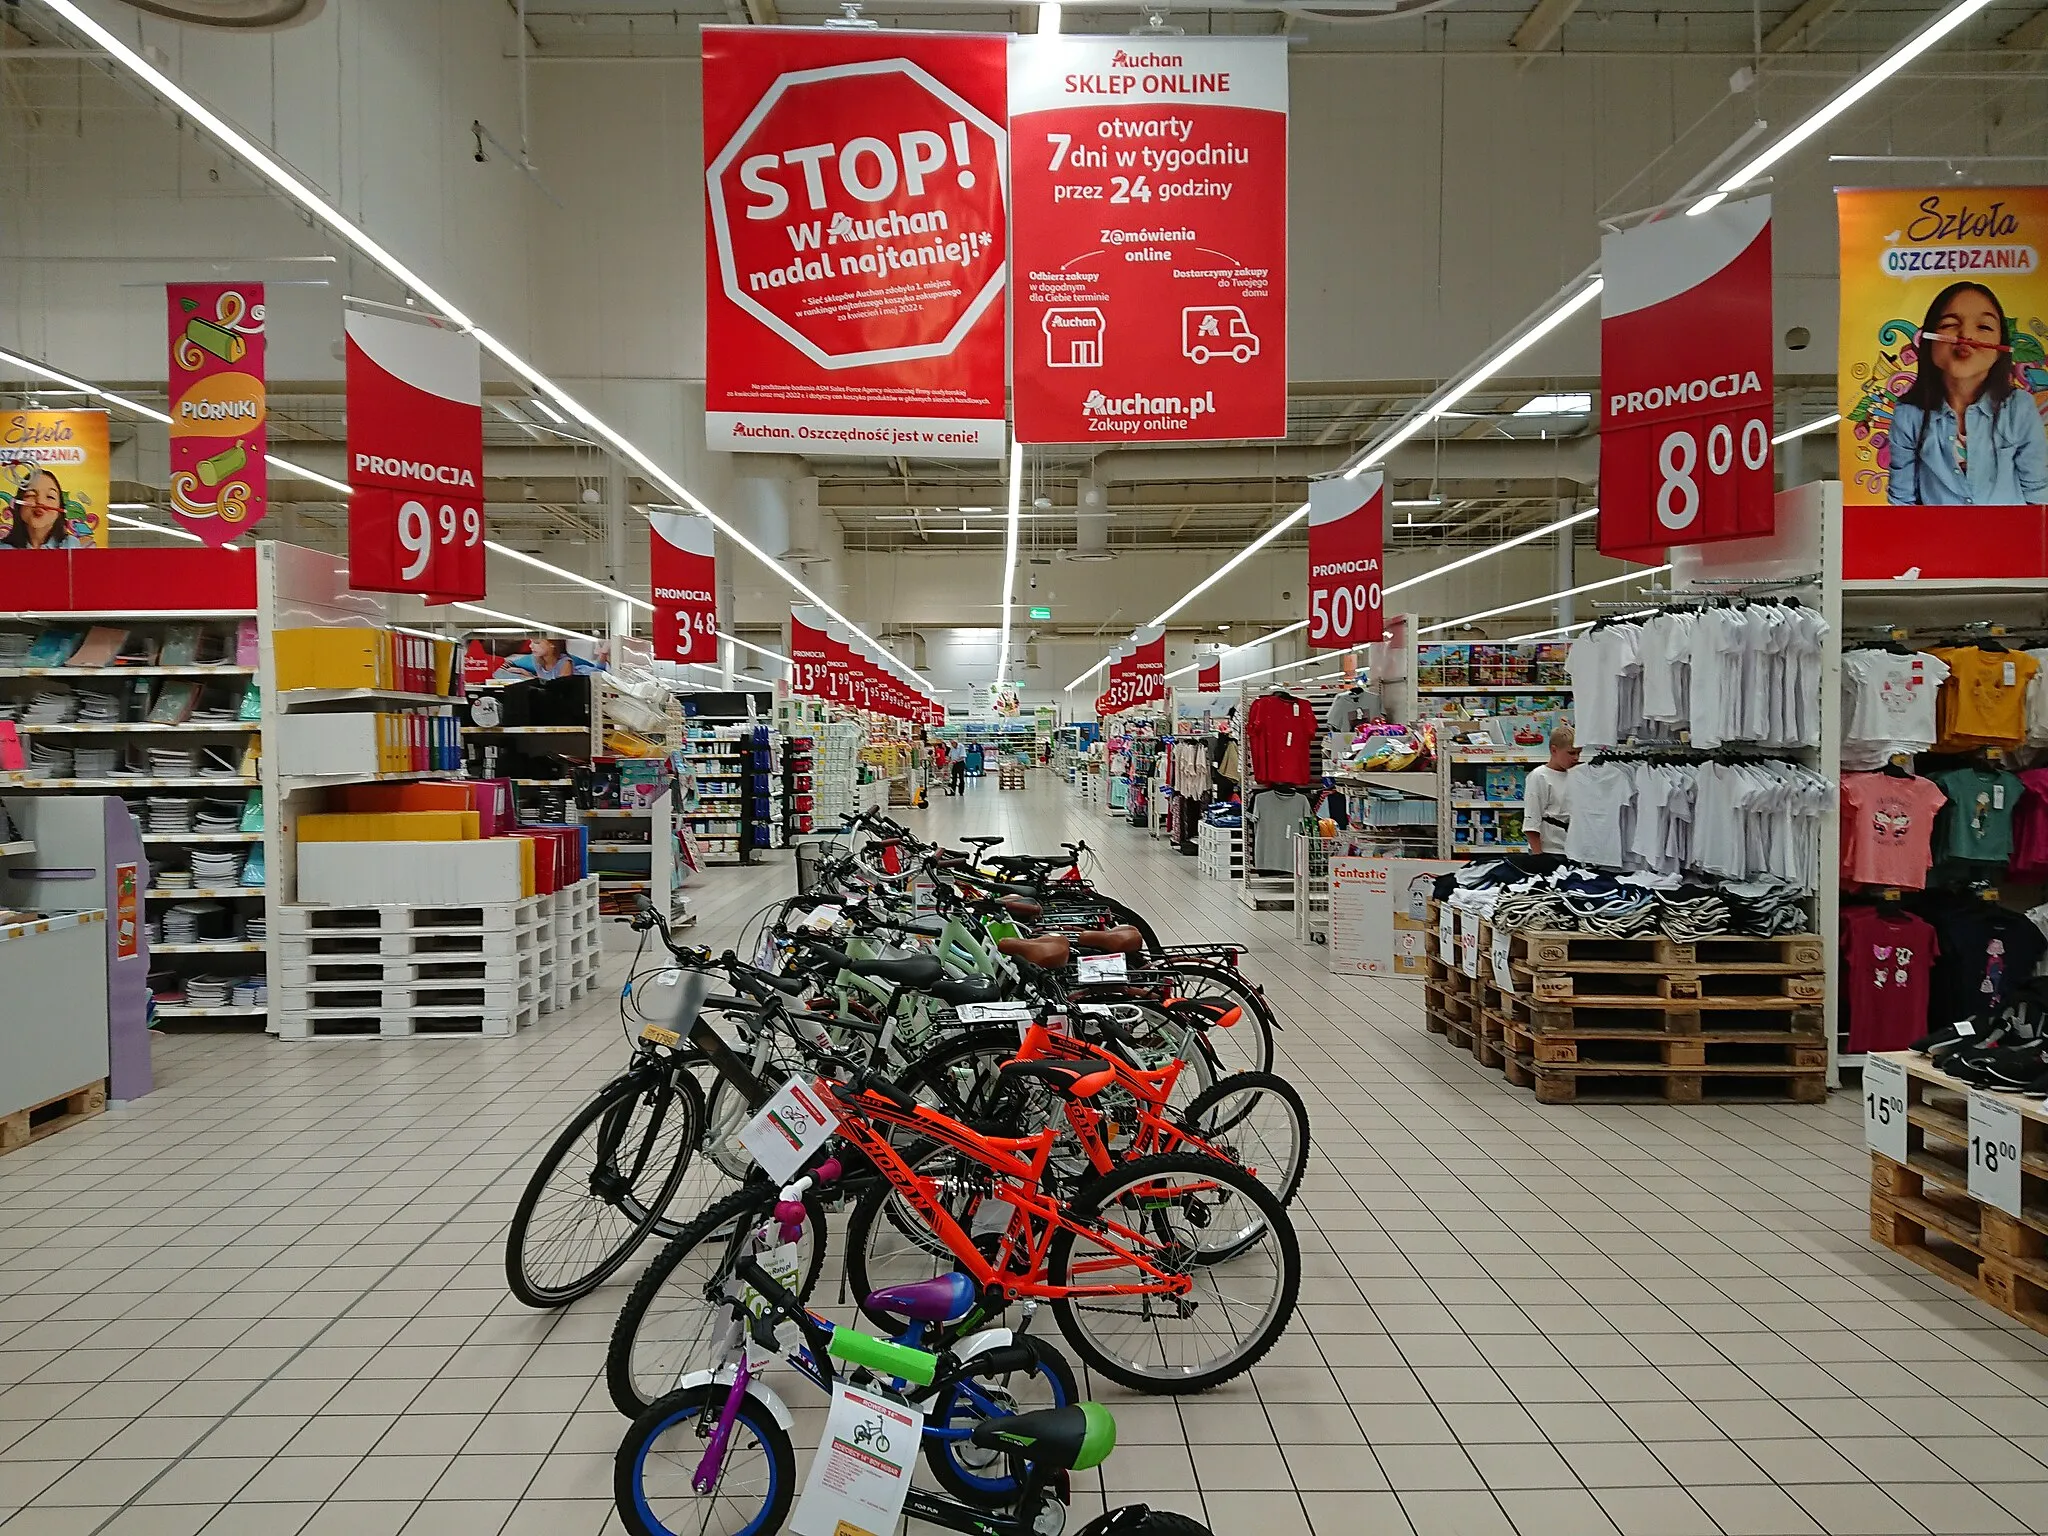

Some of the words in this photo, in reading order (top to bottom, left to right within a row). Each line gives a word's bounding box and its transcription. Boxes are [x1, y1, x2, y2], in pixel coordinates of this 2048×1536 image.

[1112, 50, 1182, 68] Auchan
[1065, 74, 1136, 94] SKLEP
[1142, 73, 1230, 93] ONLINE
[1098, 115, 1193, 142] otwarty
[1047, 133, 1071, 172] 7
[1071, 145, 1107, 168] dni
[1115, 149, 1136, 167] w
[1142, 142, 1249, 173] tygodniu
[740, 120, 975, 220] STOP!
[1054, 183, 1103, 203] przez
[1109, 175, 1151, 204] 24
[1158, 178, 1233, 202] godziny
[826, 210, 948, 244] Auchan
[1907, 196, 2018, 241] Szkoła
[1100, 227, 1196, 245] Z@mówienia
[1125, 247, 1172, 262] online
[1888, 250, 2030, 273] OSZCZĘDZANIA
[750, 252, 835, 292] nadal
[1029, 271, 1064, 281] Odbierz
[1065, 271, 1099, 283] zakupy
[1173, 269, 1233, 278] Dostarczymy
[1234, 267, 1268, 277] zakupy
[1039, 283, 1086, 293] dogodnym
[1218, 279, 1230, 287] do
[1232, 278, 1268, 288] Twojego
[855, 288, 886, 298] Auchan
[1029, 293, 1044, 301] dla
[1045, 293, 1072, 301] Ciebie
[1073, 292, 1110, 301] terminie
[1242, 289, 1268, 297] domu
[803, 304, 838, 317] rankingu
[1051, 315, 1097, 327] Auchan
[1610, 371, 1762, 416] PROMOCJA
[181, 399, 257, 421] PIÓRNIKI
[1082, 389, 1215, 419] Auchan.pl
[733, 422, 795, 438] Auchan.
[798, 426, 890, 442] Oszczędność
[892, 428, 919, 444] jest
[922, 432, 934, 442] w
[937, 430, 979, 443] cenie!
[1088, 417, 1140, 433] Zakupy
[1143, 416, 1188, 430] online
[354, 453, 476, 488] PROMOCJA
[1312, 558, 1378, 577] PROMOCJA
[654, 587, 712, 602] PROMOCJA
[1334, 867, 1386, 879] fantastic
